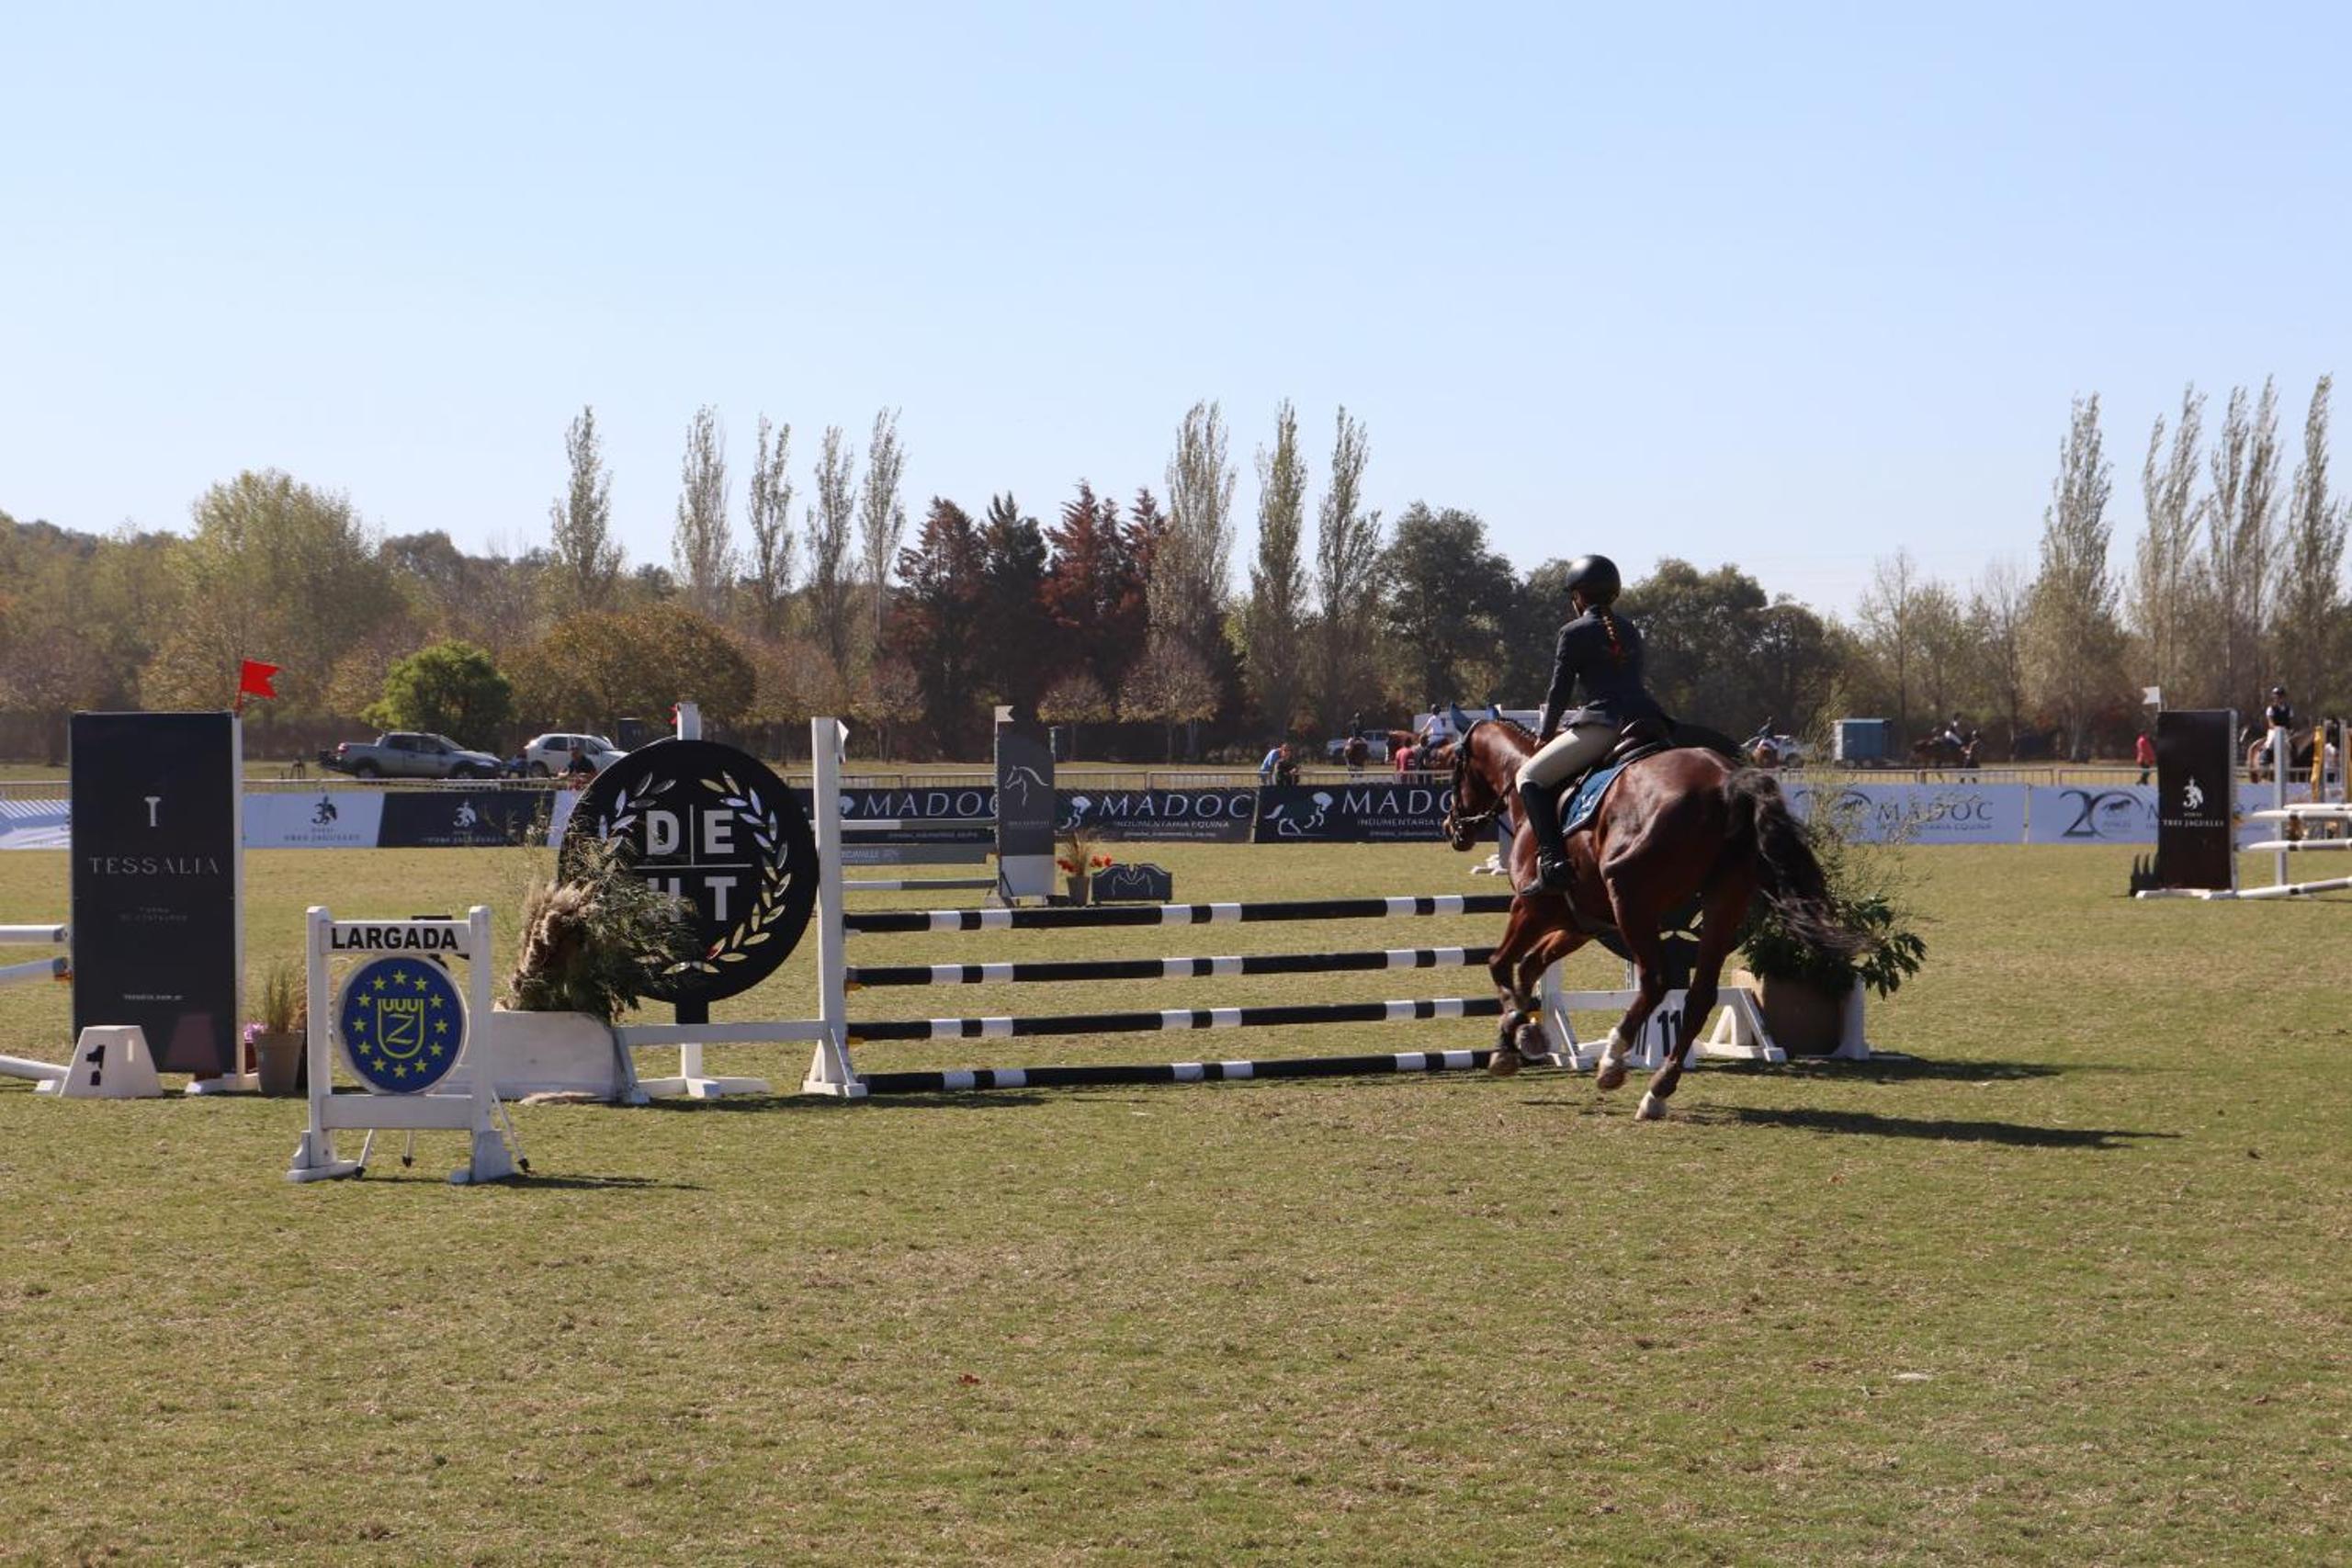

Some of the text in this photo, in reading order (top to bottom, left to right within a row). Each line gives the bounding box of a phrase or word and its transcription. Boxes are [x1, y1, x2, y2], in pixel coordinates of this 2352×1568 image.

[1100, 794, 1252, 818] MADOC
[89, 857, 219, 874] TESSALIA
[331, 927, 458, 950] LARGADA
[85, 1044, 106, 1086] 1
